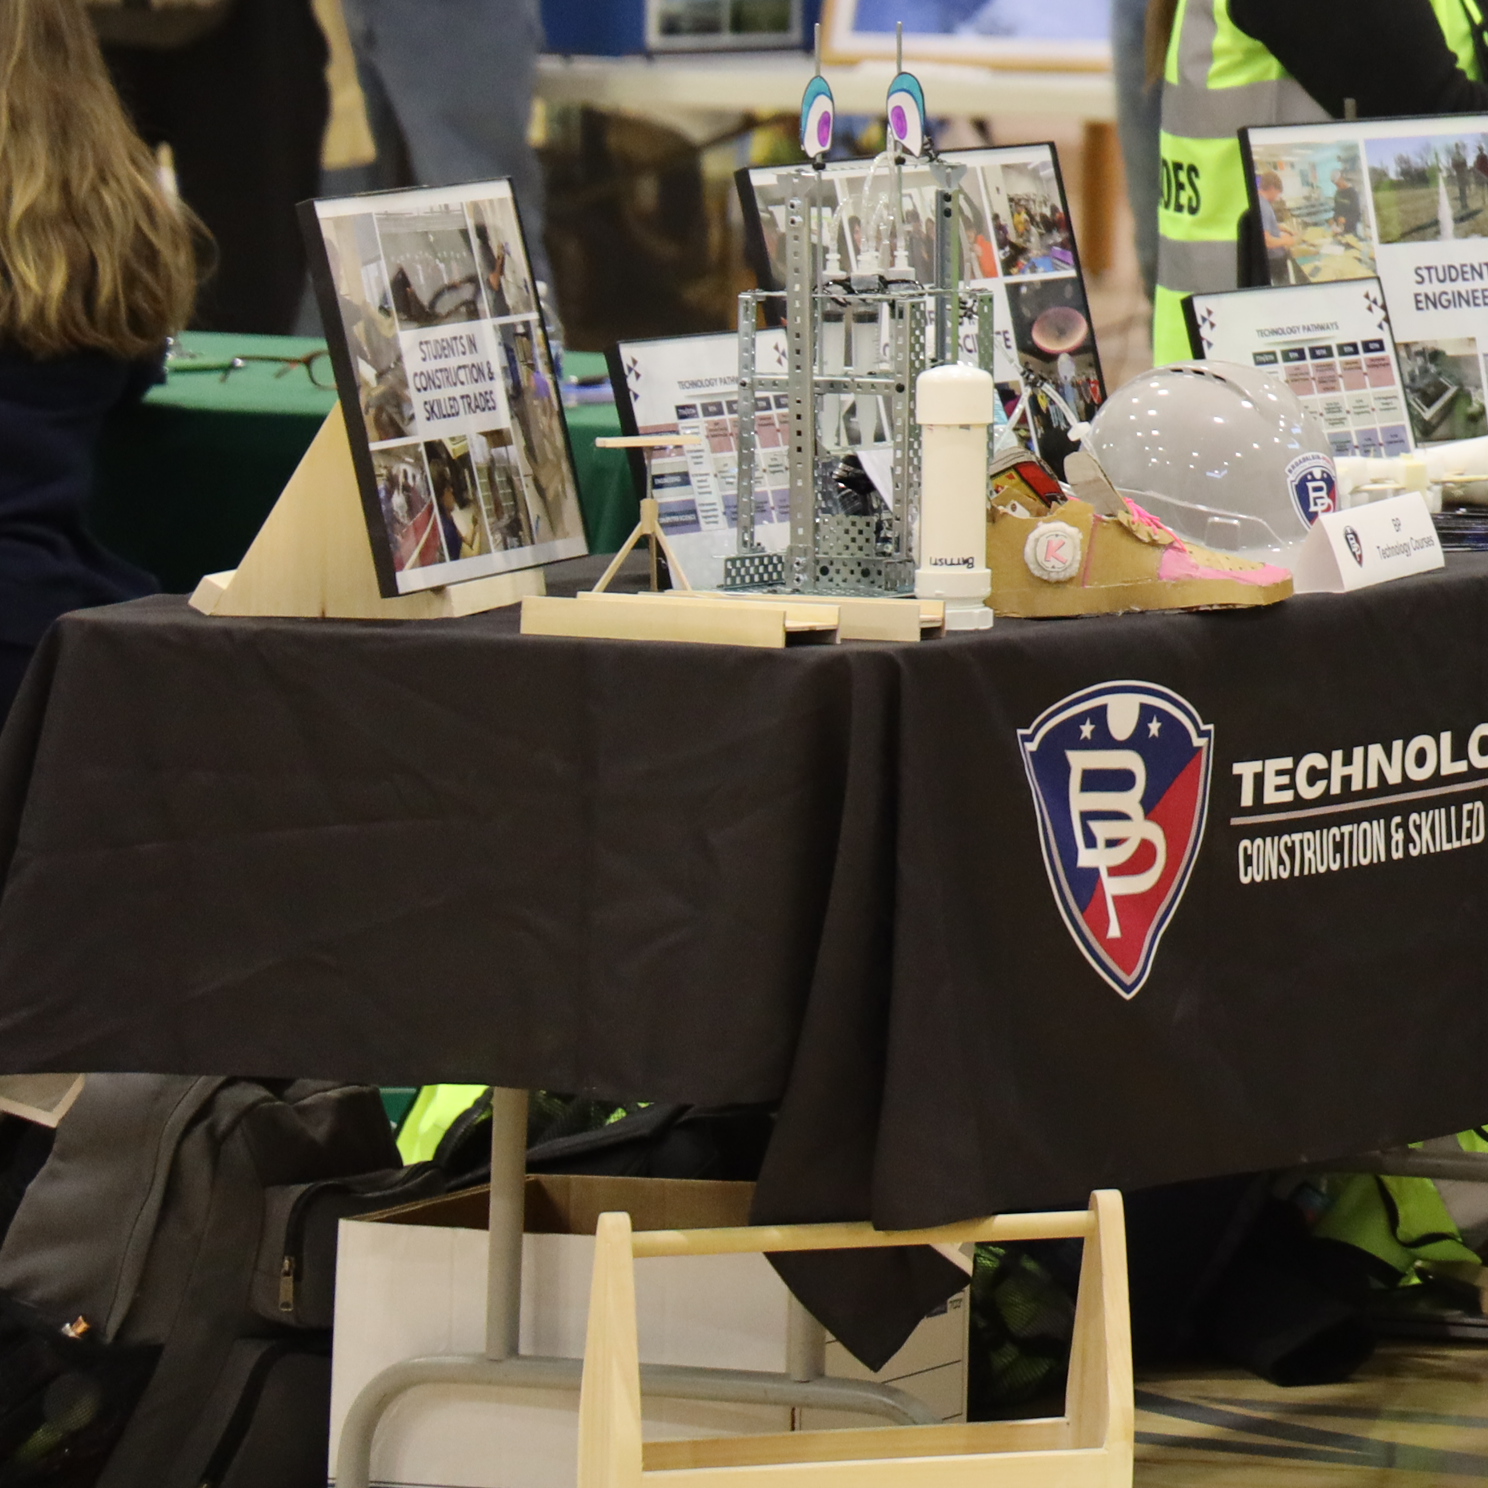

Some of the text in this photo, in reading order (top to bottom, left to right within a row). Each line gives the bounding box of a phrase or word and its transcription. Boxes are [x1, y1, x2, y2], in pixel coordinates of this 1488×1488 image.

[1256, 321, 1340, 338] TECHNOLOGY PATHWAYS
[418, 333, 478, 363] STUDENTS IN
[413, 360, 496, 393] CONSTRUCTION &
[677, 376, 739, 390] TECHNOLOGY PATHW
[423, 390, 497, 422] SKILLED TRADES
[1391, 518, 1402, 532] BP
[1045, 539, 1068, 564] K
[1376, 534, 1436, 560] Technology Courses
[1238, 819, 1386, 884] CONSTRUCTION
[1390, 815, 1404, 859] &
[1408, 800, 1486, 857] SKILLED
